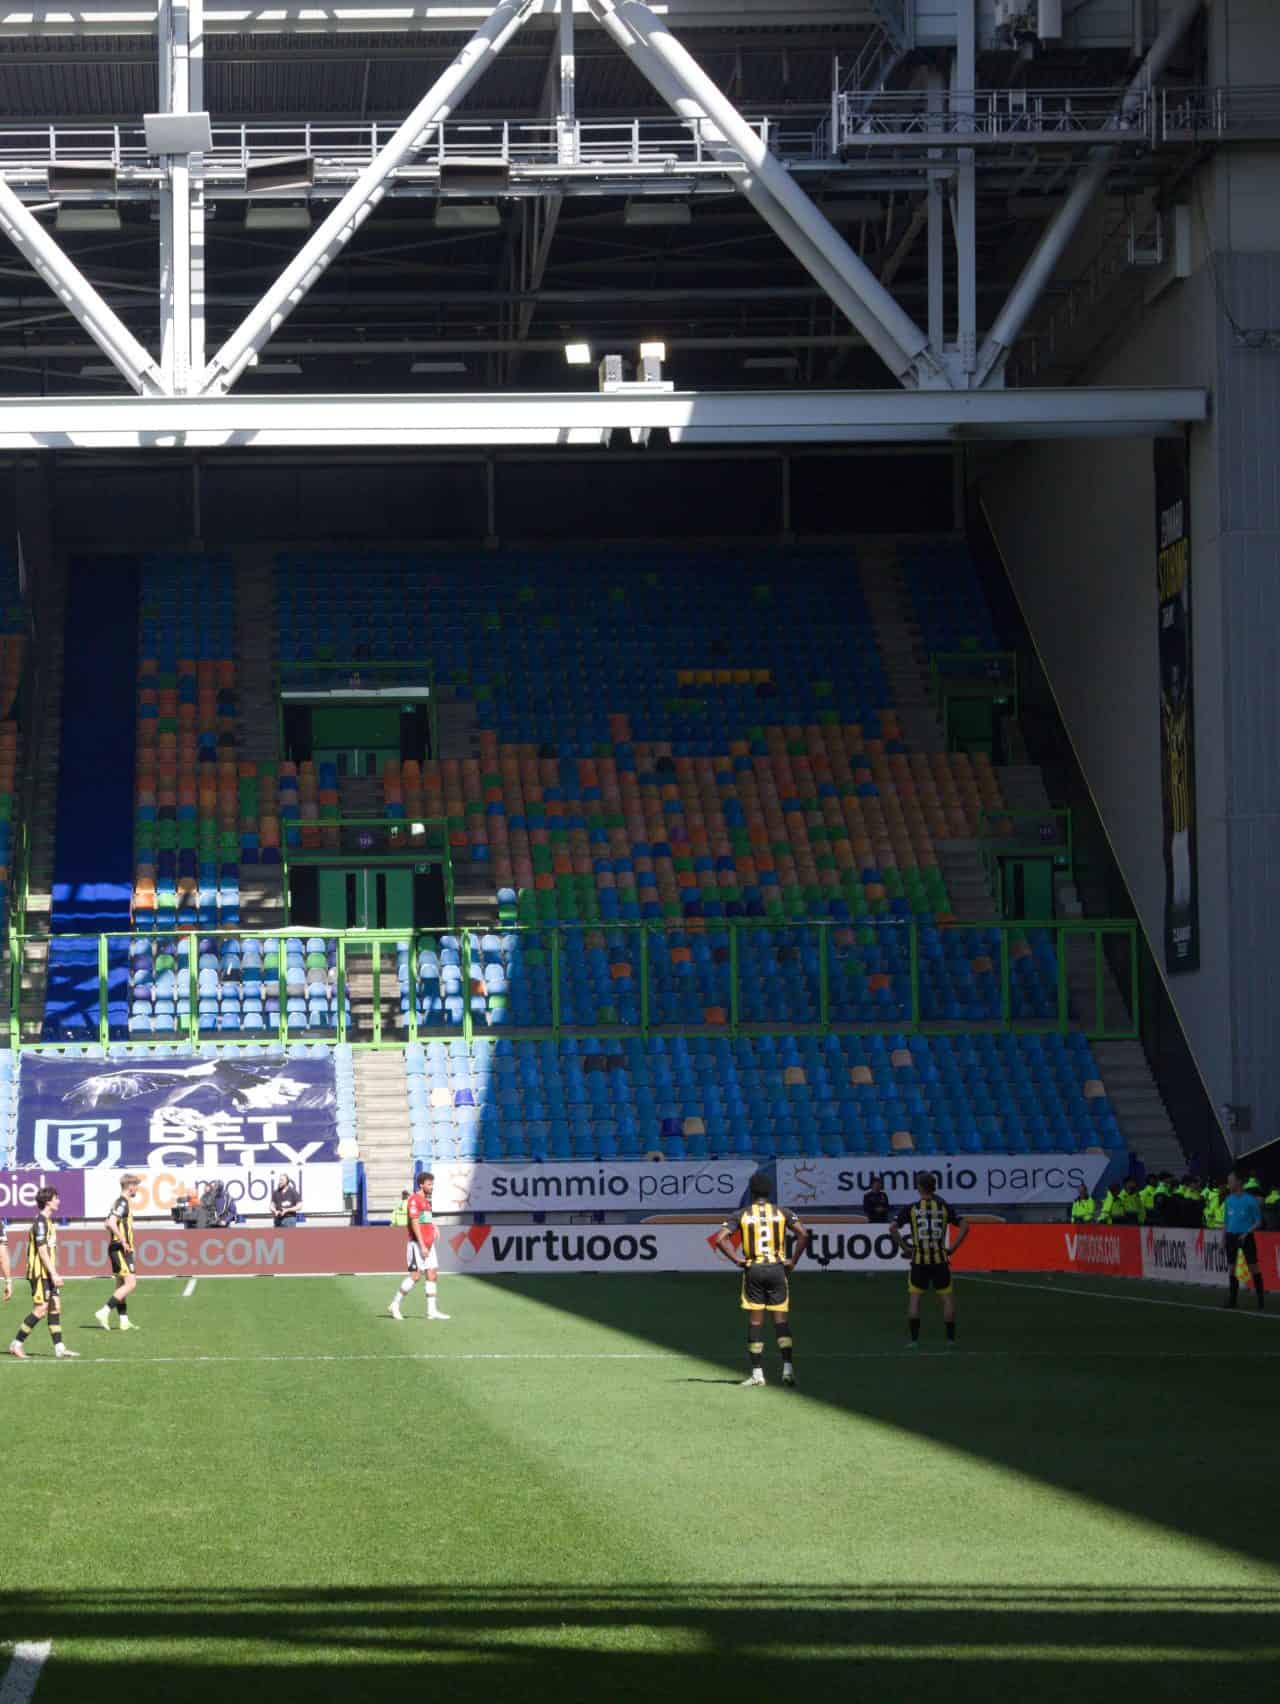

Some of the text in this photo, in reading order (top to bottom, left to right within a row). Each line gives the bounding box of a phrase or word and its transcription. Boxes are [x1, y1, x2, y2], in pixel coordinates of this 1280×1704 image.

[149, 1107, 292, 1143] BET
[147, 1141, 324, 1168] CITY
[491, 1169, 734, 1202] summio parcs
[987, 1166, 1086, 1196] parcs
[917, 1218, 943, 1240] 25
[8, 1238, 285, 1266] VTUOS.COM
[492, 1230, 658, 1261] virtuoos
[785, 1229, 912, 1260] rtuoo
